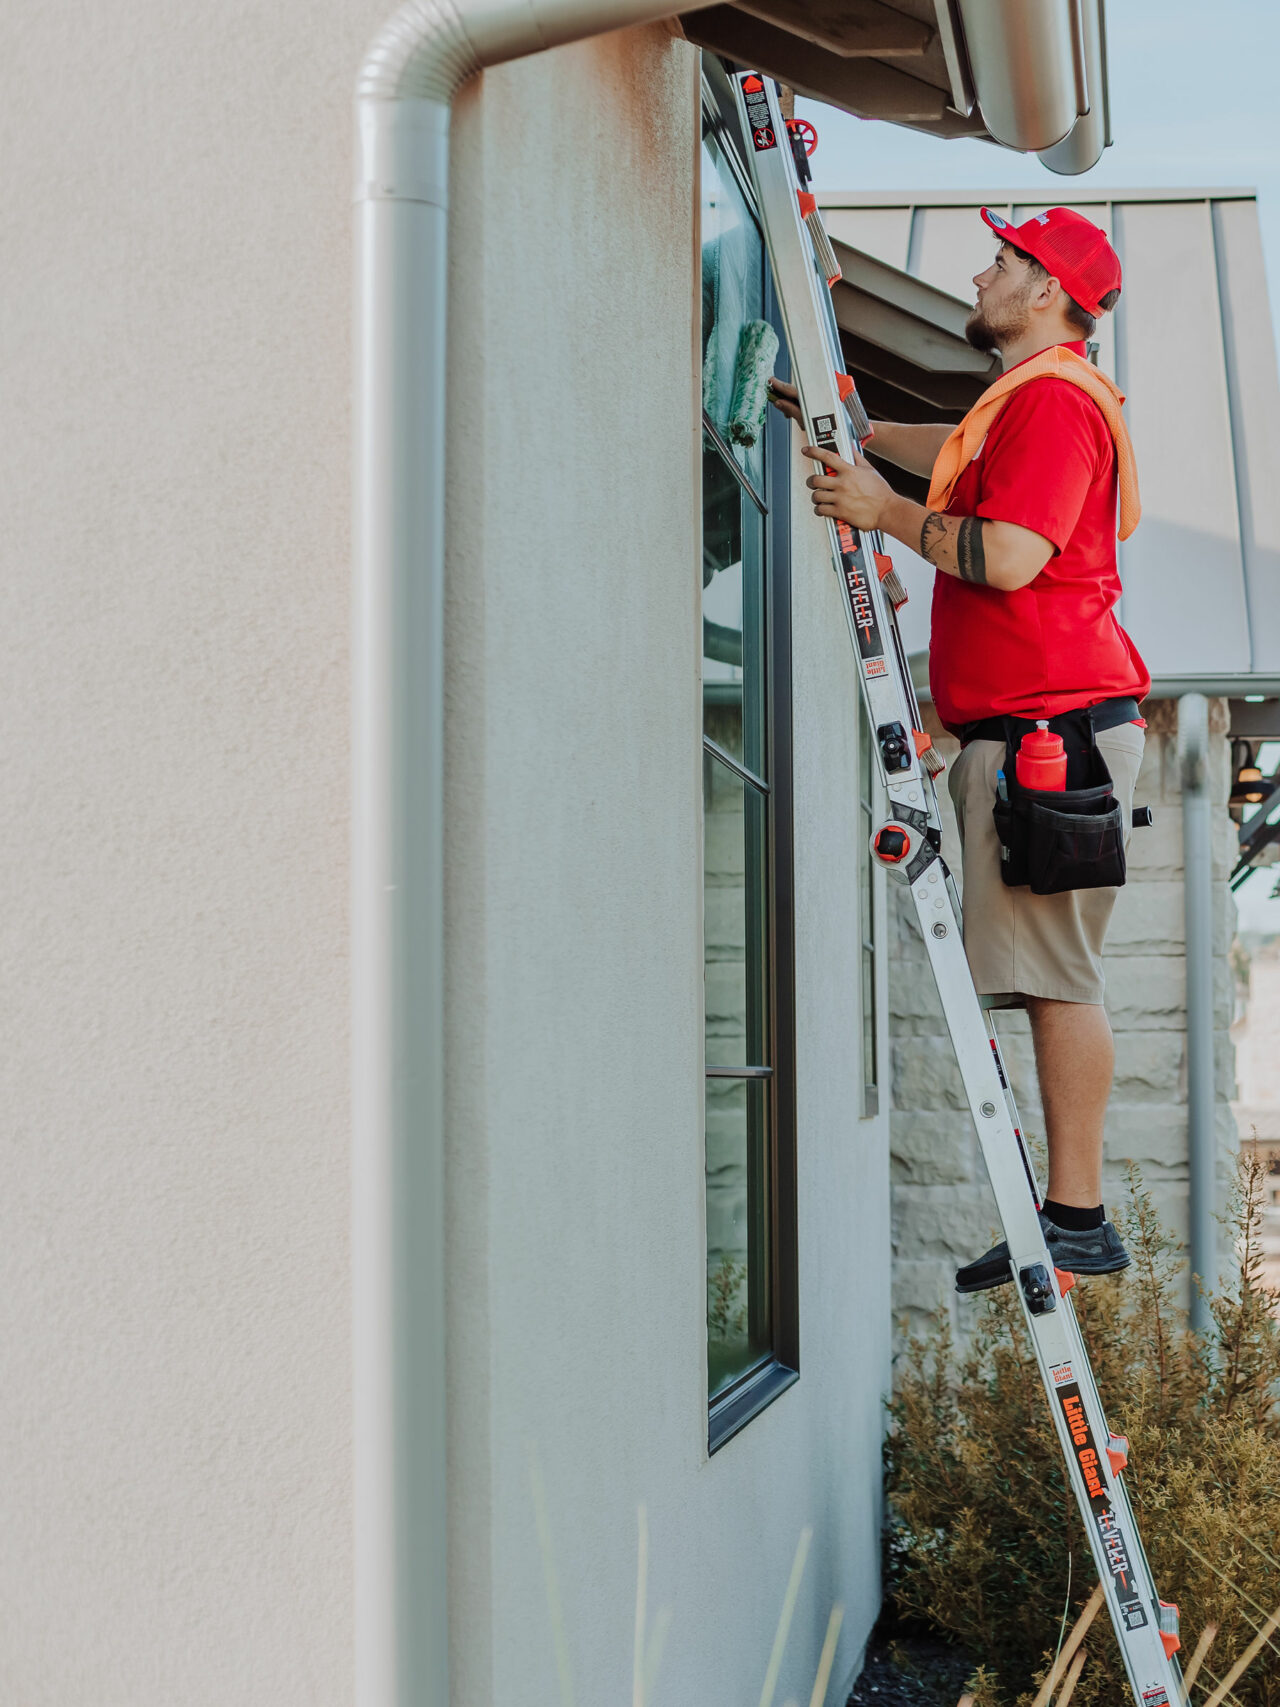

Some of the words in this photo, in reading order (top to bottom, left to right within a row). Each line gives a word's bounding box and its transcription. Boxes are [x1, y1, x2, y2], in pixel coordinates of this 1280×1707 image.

[847, 569, 874, 628] LEVELER
[866, 659, 884, 669] Giant
[867, 666, 886, 675] Little
[1052, 1366, 1071, 1376] Little
[1054, 1373, 1072, 1382] Giant
[1062, 1395, 1088, 1446] Little
[1078, 1448, 1104, 1498] Giant
[1097, 1509, 1129, 1575] LEVELER
